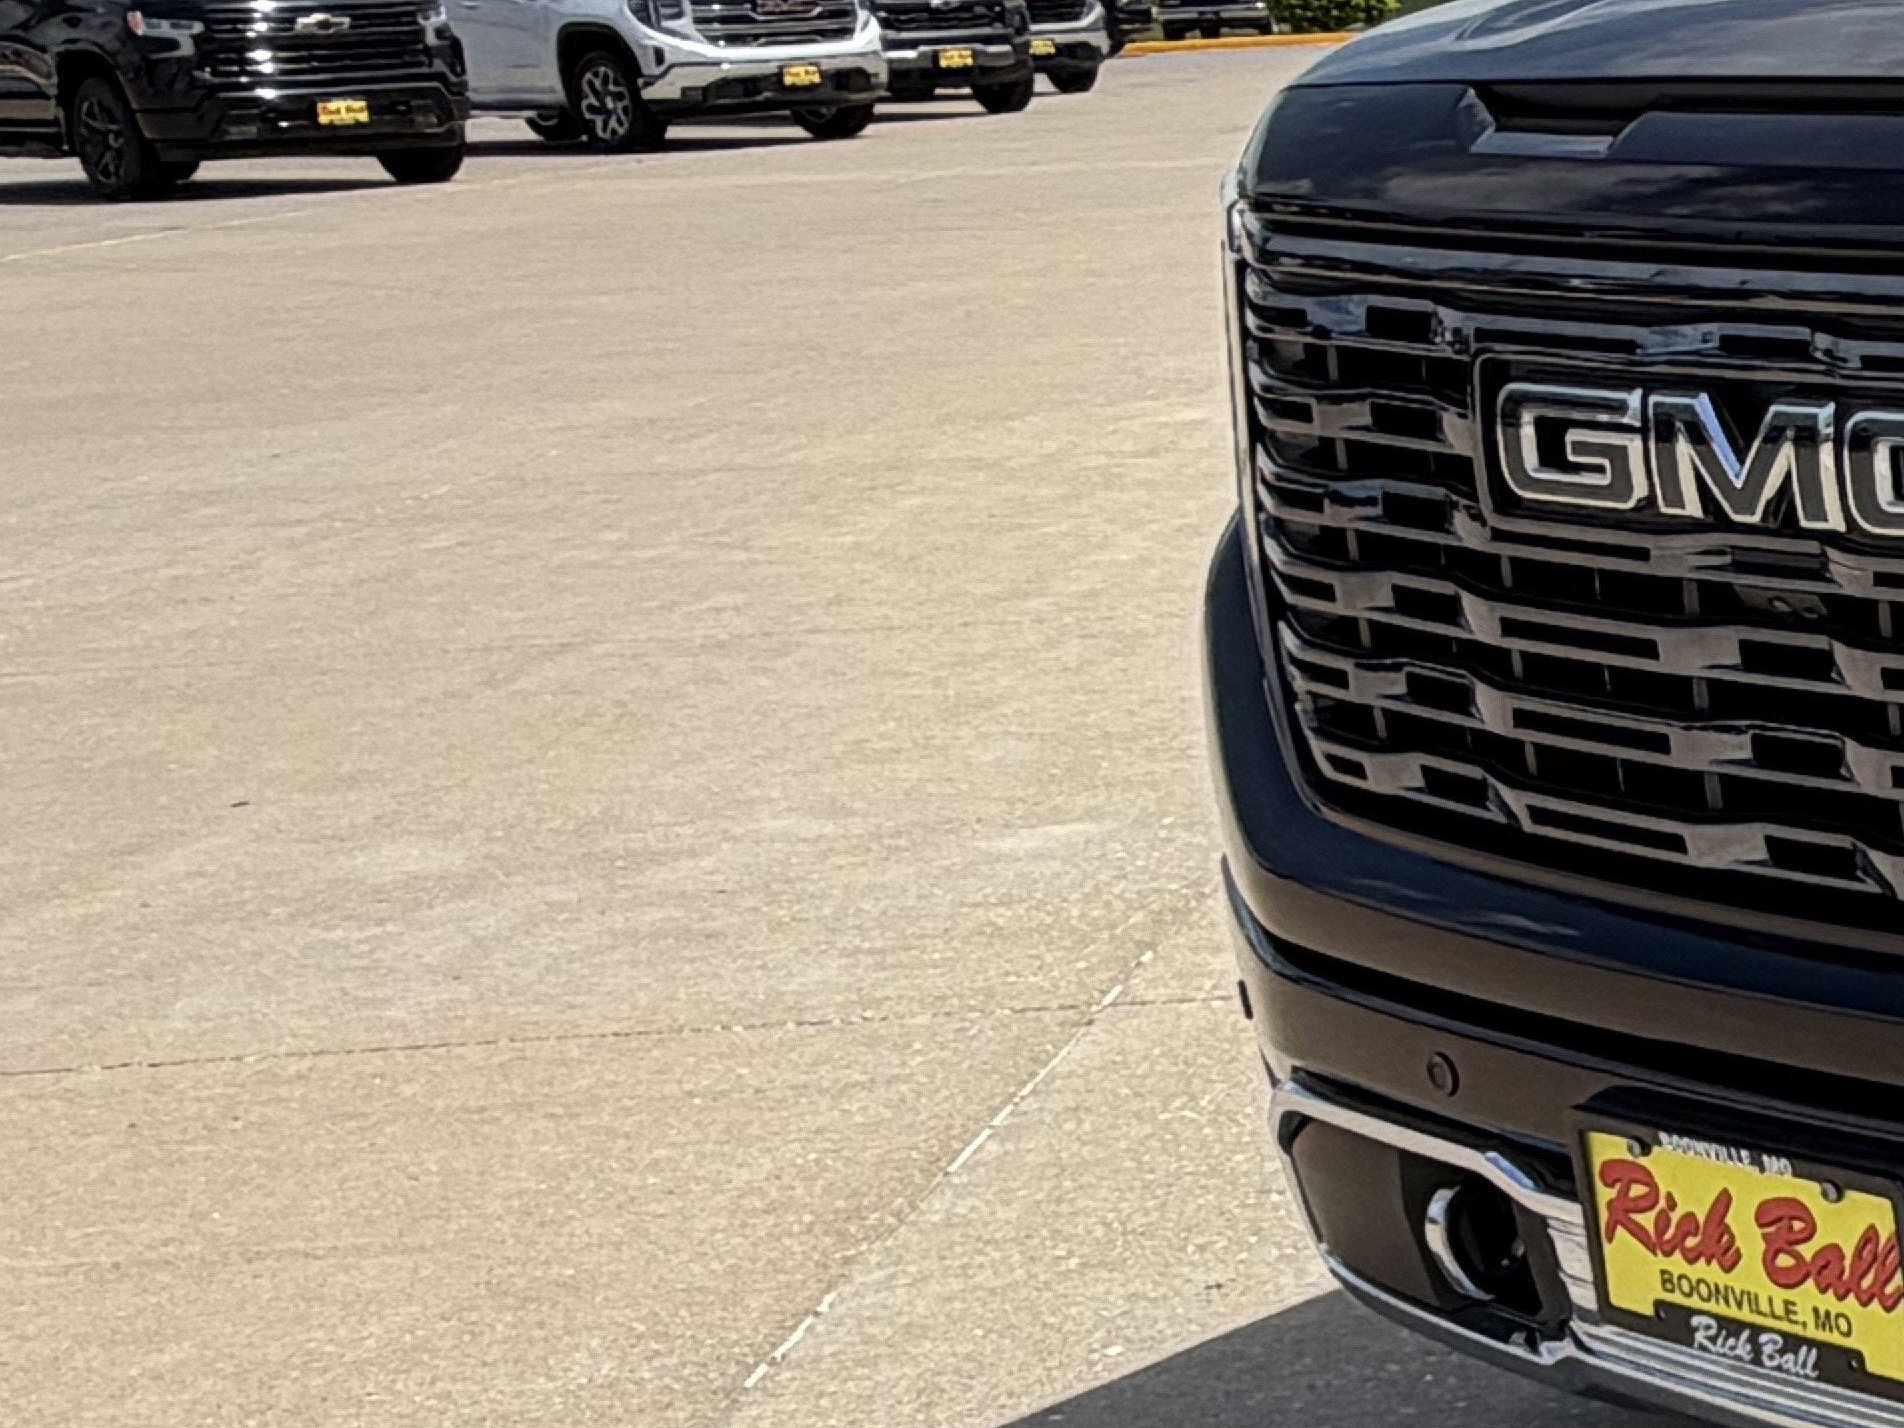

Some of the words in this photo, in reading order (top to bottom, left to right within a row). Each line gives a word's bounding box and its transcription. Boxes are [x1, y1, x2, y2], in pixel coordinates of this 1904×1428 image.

[1599, 1157, 1742, 1274] Rick
[1658, 1268, 1808, 1332] BOONVILLE,
[1812, 1305, 1854, 1338] MO
[1690, 1315, 1754, 1362] Rick
[1759, 1334, 1820, 1378] Ball
